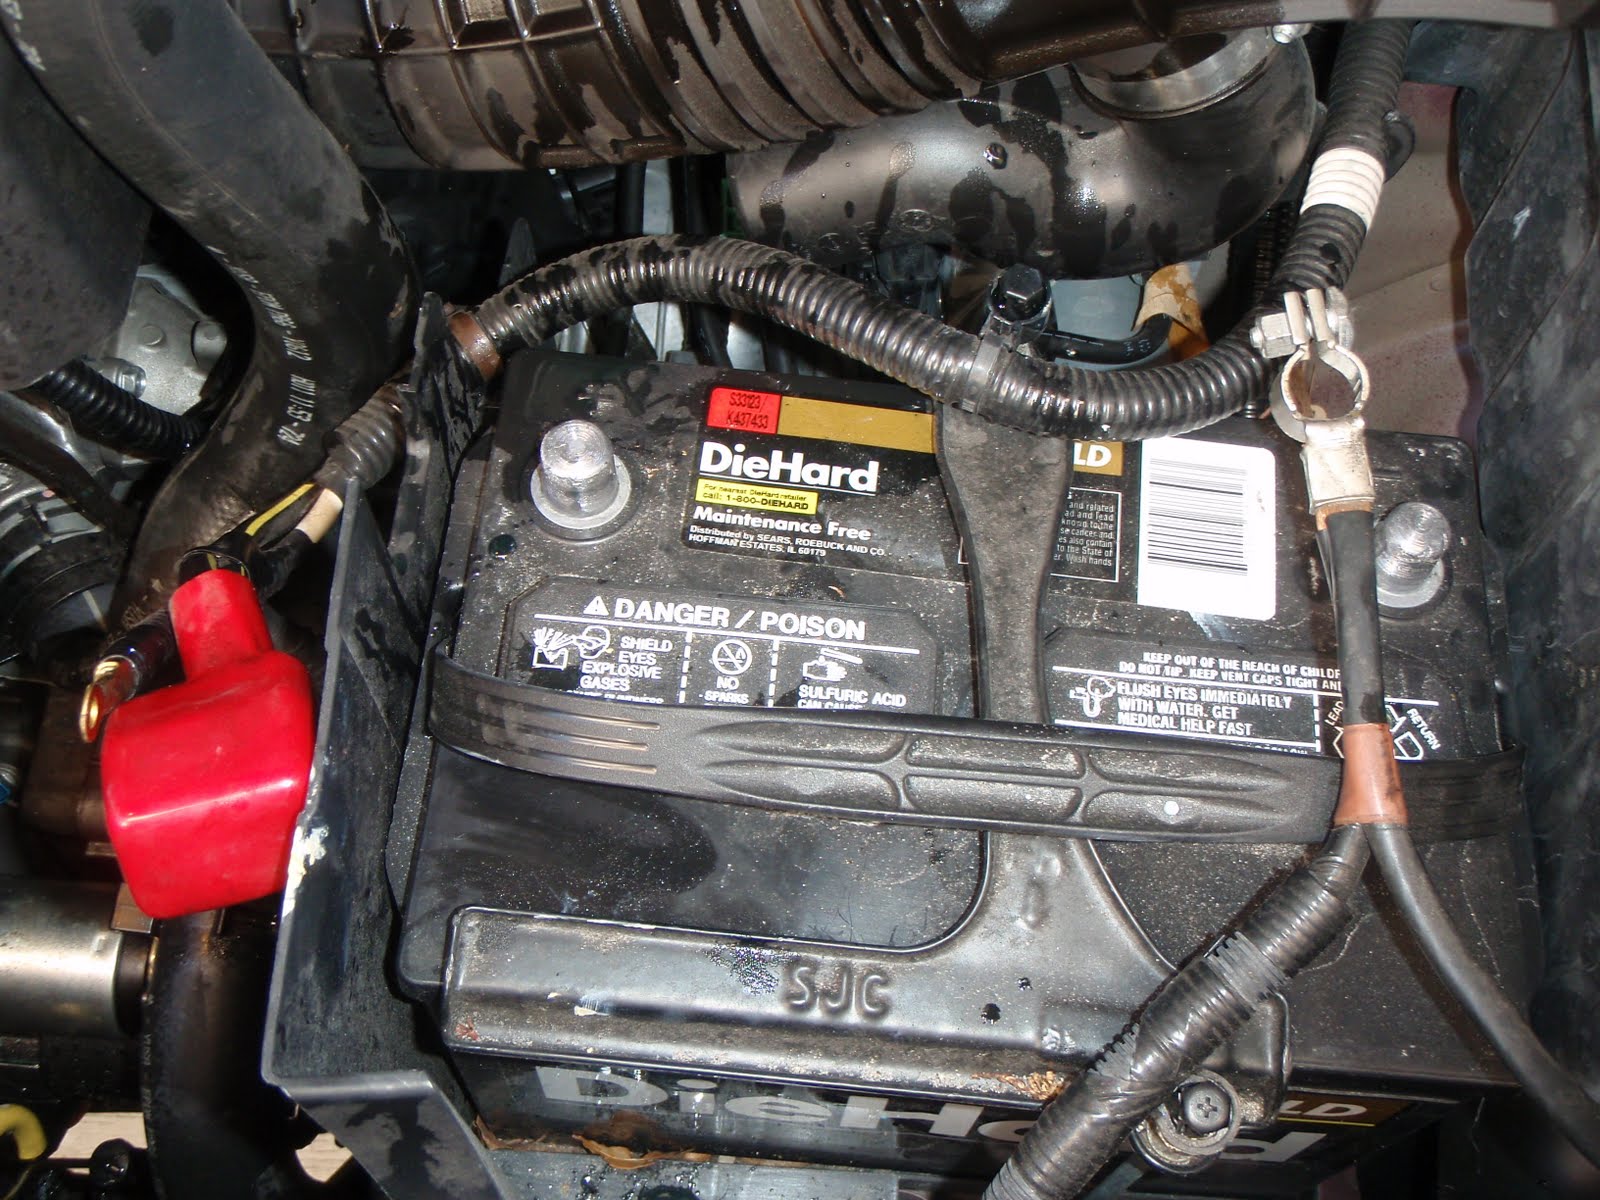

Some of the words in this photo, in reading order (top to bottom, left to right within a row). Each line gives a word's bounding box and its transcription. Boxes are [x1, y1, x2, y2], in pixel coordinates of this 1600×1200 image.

[727, 410, 769, 429] K437433
[700, 441, 880, 492] DieHard
[703, 492, 722, 500] call:
[726, 494, 809, 510] 1-800-DIEHARD
[719, 485, 747, 495] nearest
[749, 489, 780, 499] DieHard
[1069, 501, 1084, 509] and
[1086, 502, 1114, 513] related
[1076, 511, 1093, 519] and
[1095, 511, 1114, 522] lead
[693, 505, 822, 534] Maintenance
[827, 521, 872, 540] Free
[1090, 520, 1097, 529] to
[1098, 520, 1114, 530] the
[690, 525, 741, 539] Distributed
[743, 531, 755, 541] by
[795, 538, 845, 551] ROEBUCK
[846, 544, 869, 554] AND
[870, 548, 887, 556] CO.
[1069, 537, 1084, 545] also
[1085, 538, 1113, 548] contain
[1071, 528, 1097, 537] cancer
[1098, 531, 1113, 539] and
[689, 534, 738, 547] HOFFMAN
[787, 546, 797, 554] IL
[798, 547, 827, 557] 60179
[1067, 545, 1080, 553] the
[1082, 546, 1102, 556] State
[1104, 549, 1113, 557] of
[1088, 556, 1112, 566] hands
[614, 598, 730, 628] DANGER
[734, 610, 755, 628] /
[759, 610, 866, 640] POISON
[620, 635, 673, 652] SHIELD
[618, 651, 657, 666] EYES
[1143, 652, 1172, 664] KEEP
[1174, 655, 1198, 666] OUT
[1199, 657, 1217, 668] OF
[1218, 658, 1240, 670] THE
[1242, 660, 1280, 673] REACH
[1282, 664, 1297, 675] OF
[581, 660, 663, 679] EXPLOSIVE
[1119, 661, 1136, 673] DO
[1138, 663, 1161, 675] NOT
[1190, 668, 1218, 680] KEEP
[1221, 671, 1249, 682] VENT
[1252, 673, 1282, 686] CAPS
[1285, 676, 1318, 688] TIGHT
[580, 675, 631, 691] GASES
[716, 676, 739, 691] NO
[704, 690, 749, 705] SPARKS
[798, 684, 868, 703] SULFURIC
[872, 692, 907, 707] ACID
[1117, 681, 1161, 698] FLUSH
[1163, 685, 1198, 700] EYES
[1200, 688, 1292, 709] IMMEDIATELY
[1118, 697, 1154, 712] WITH
[1155, 700, 1208, 717] WATER.
[1212, 705, 1239, 720] GET
[1118, 712, 1178, 729] MEDICAL
[1181, 717, 1216, 733] HELP
[1218, 720, 1253, 736] FAST
[1406, 708, 1441, 750] RETURN
[783, 959, 892, 1018] SJC
